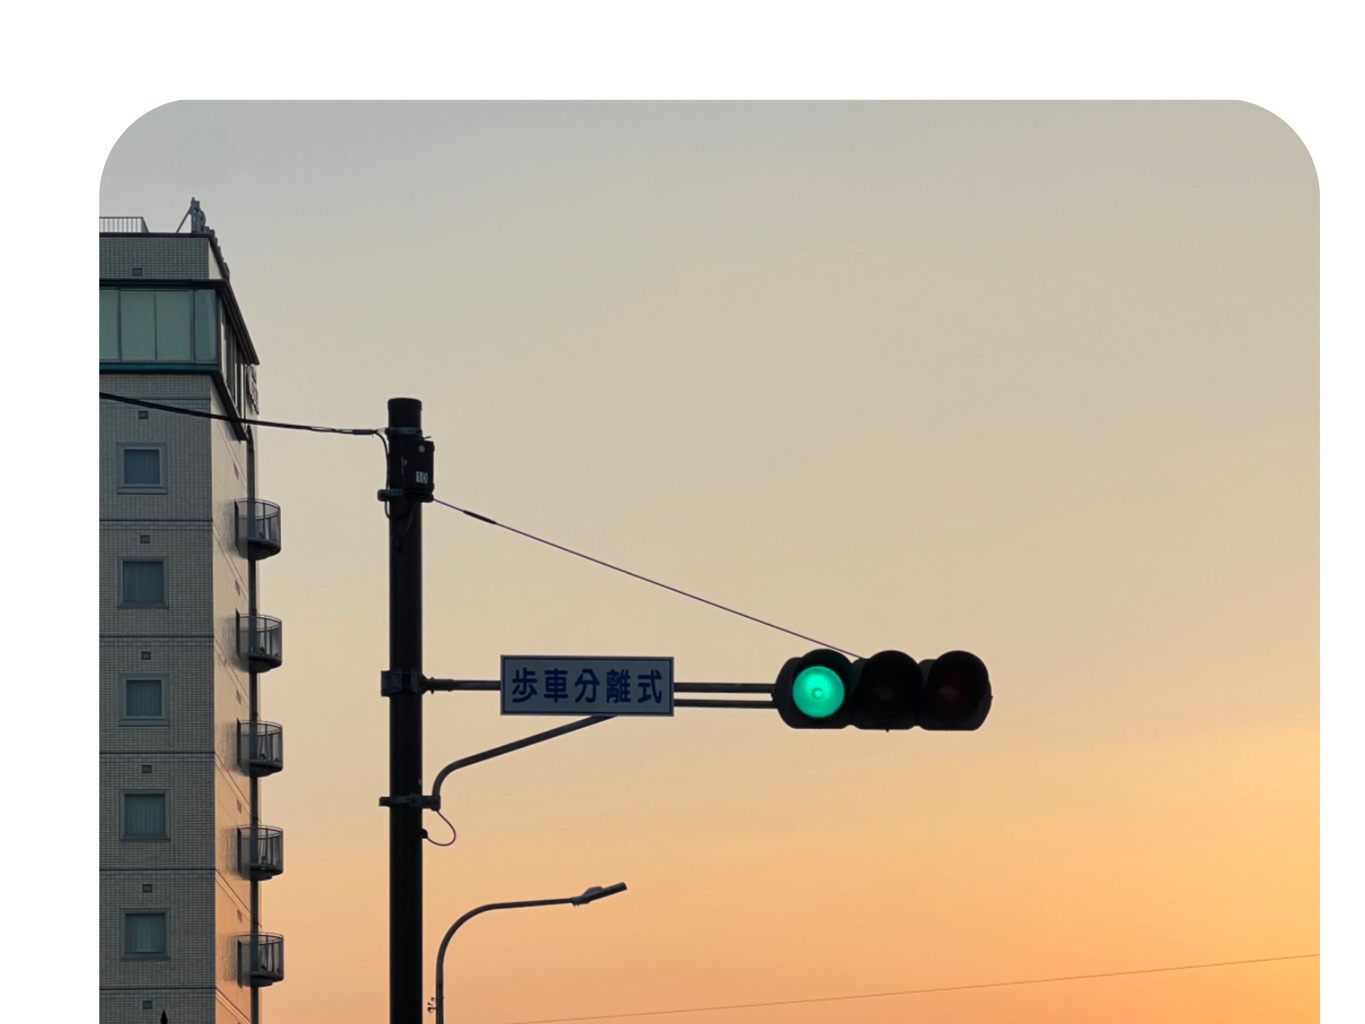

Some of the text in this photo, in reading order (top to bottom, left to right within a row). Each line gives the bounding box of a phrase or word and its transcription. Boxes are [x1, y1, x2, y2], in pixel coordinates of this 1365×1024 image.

[511, 667, 663, 704] 歩車分離式
